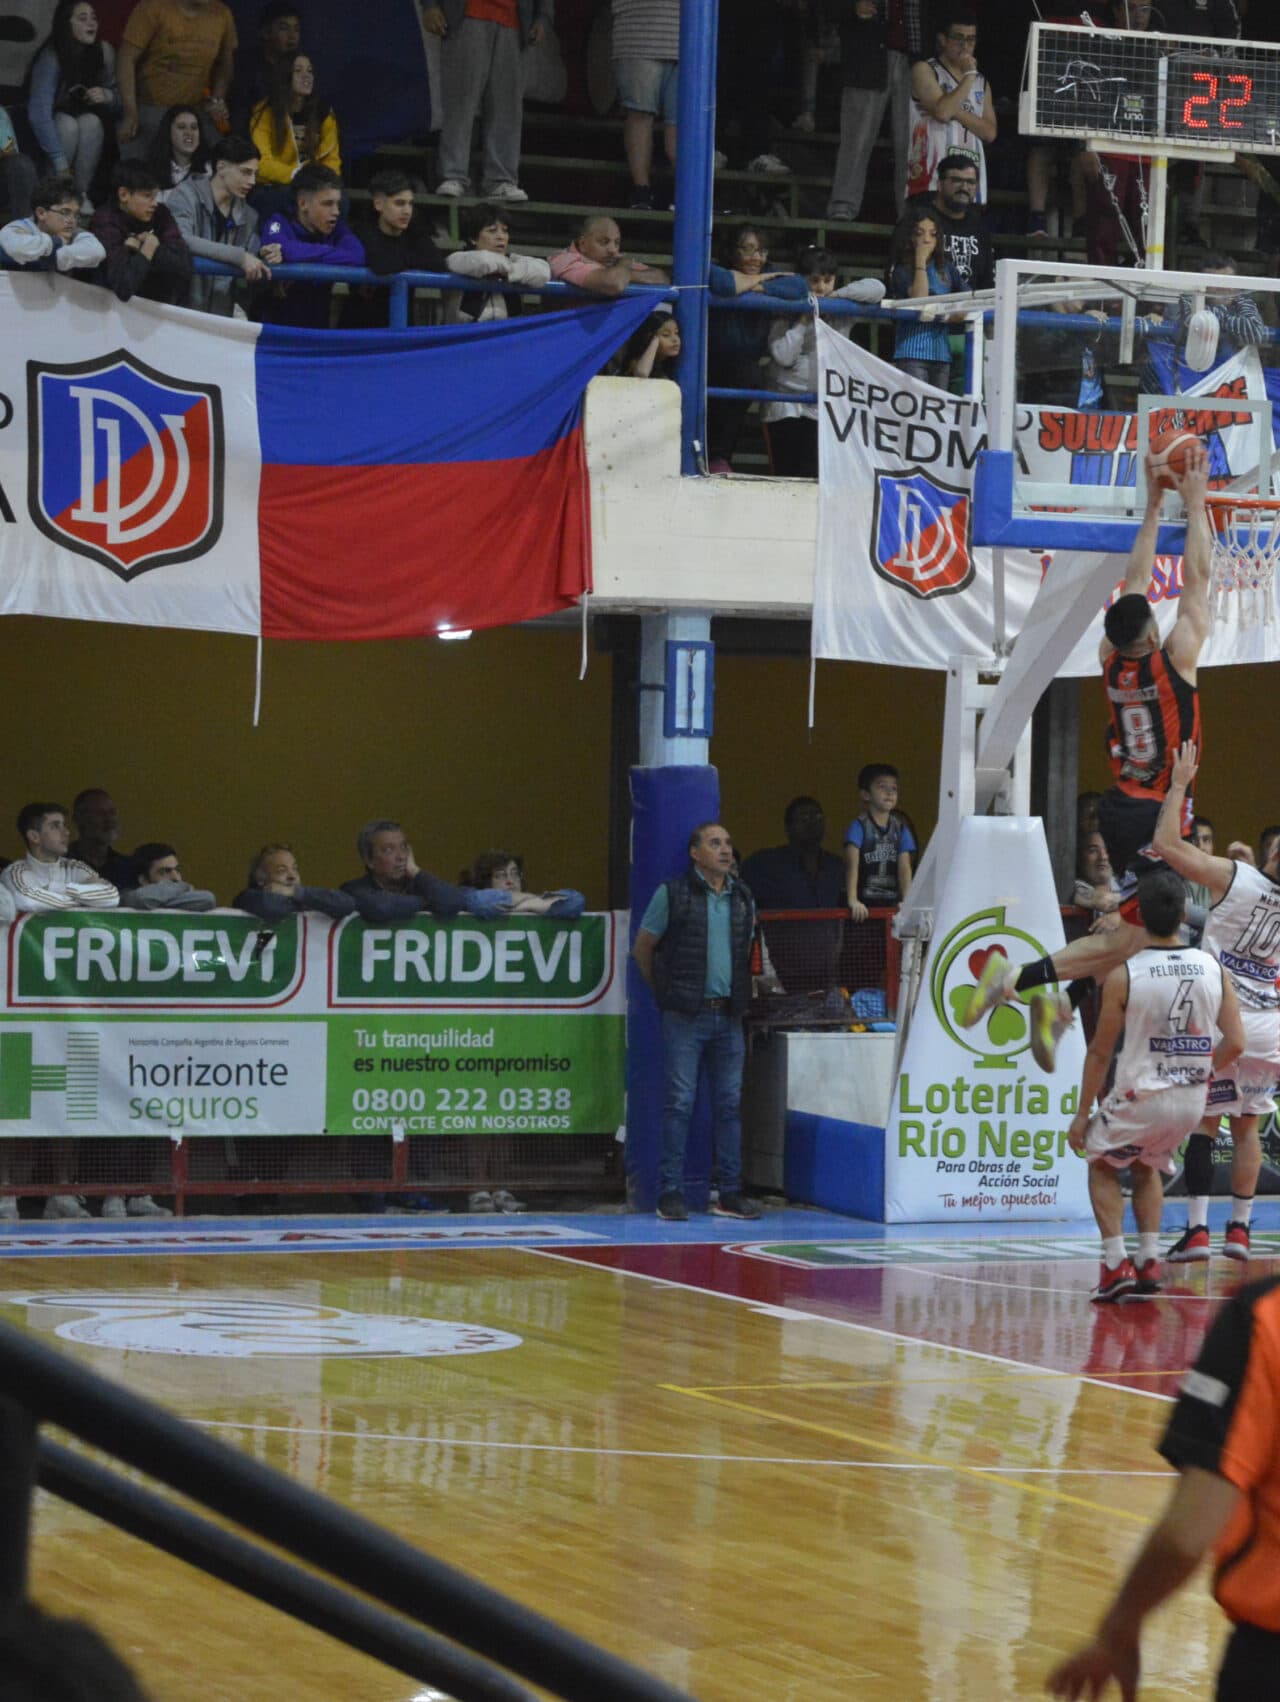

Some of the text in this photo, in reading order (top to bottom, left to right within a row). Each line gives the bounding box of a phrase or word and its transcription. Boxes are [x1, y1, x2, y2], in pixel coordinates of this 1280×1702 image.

[1183, 72, 1252, 129] 22
[43, 926, 277, 983] FRIDEVI
[361, 929, 582, 983] FRIDEVI
[1222, 951, 1279, 980] VALASTRO
[1168, 979, 1195, 1034] 4
[354, 1028, 494, 1053] Tu tranquilidad
[1151, 1038, 1211, 1052] VALASTRO
[129, 1054, 289, 1087] horizonte
[354, 1053, 571, 1077] es nuestro compromiso
[352, 1087, 571, 1111] 0800 222 0338
[900, 1073, 1085, 1115] Lotería d
[129, 1097, 258, 1127] seguros
[352, 1115, 571, 1129] CONTACTE CON NOSOTROS
[899, 1119, 1087, 1171] Río Negr
[936, 1160, 1021, 1173] Para Obras de
[978, 1174, 1059, 1187] Acción Social
[962, 1191, 997, 1211] mejor
